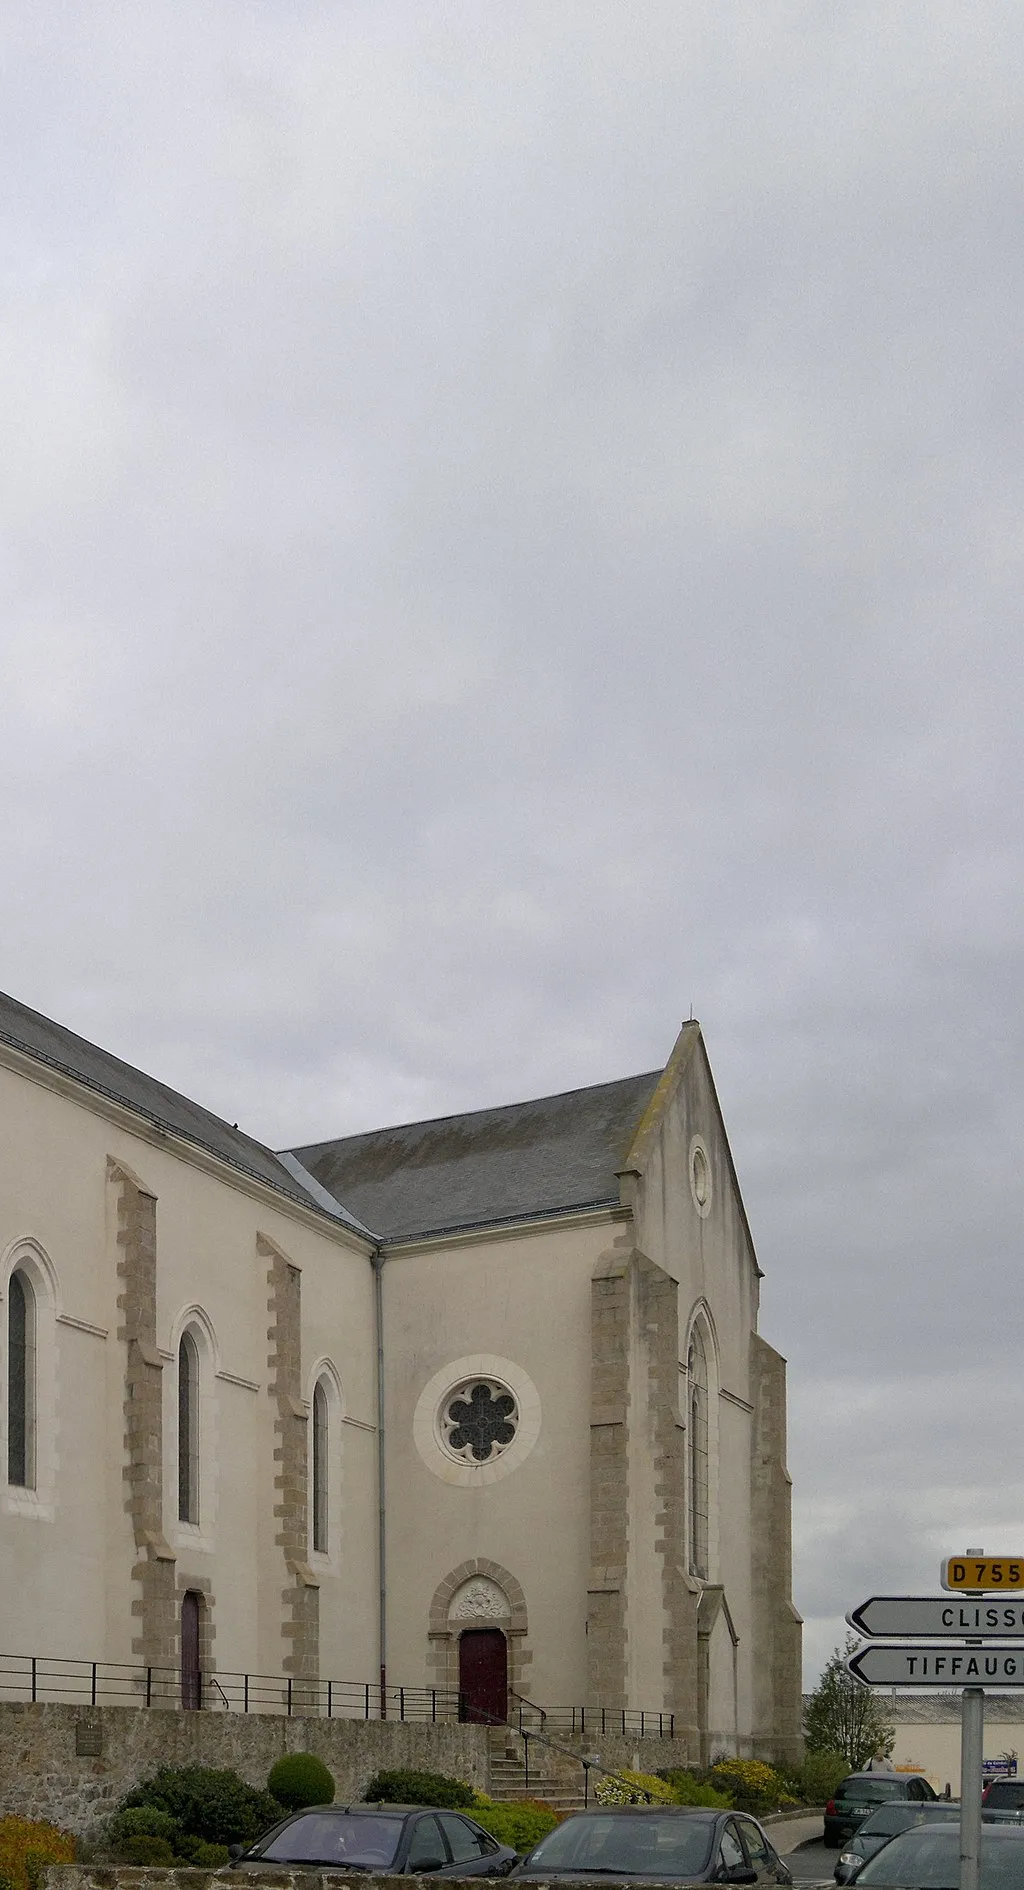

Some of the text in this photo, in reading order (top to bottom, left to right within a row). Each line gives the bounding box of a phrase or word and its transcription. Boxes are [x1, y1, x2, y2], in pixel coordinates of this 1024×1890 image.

[953, 1564, 1021, 1583] D 755
[941, 1608, 1024, 1627] CLISS
[906, 1657, 1024, 1676] TIFFAUG
